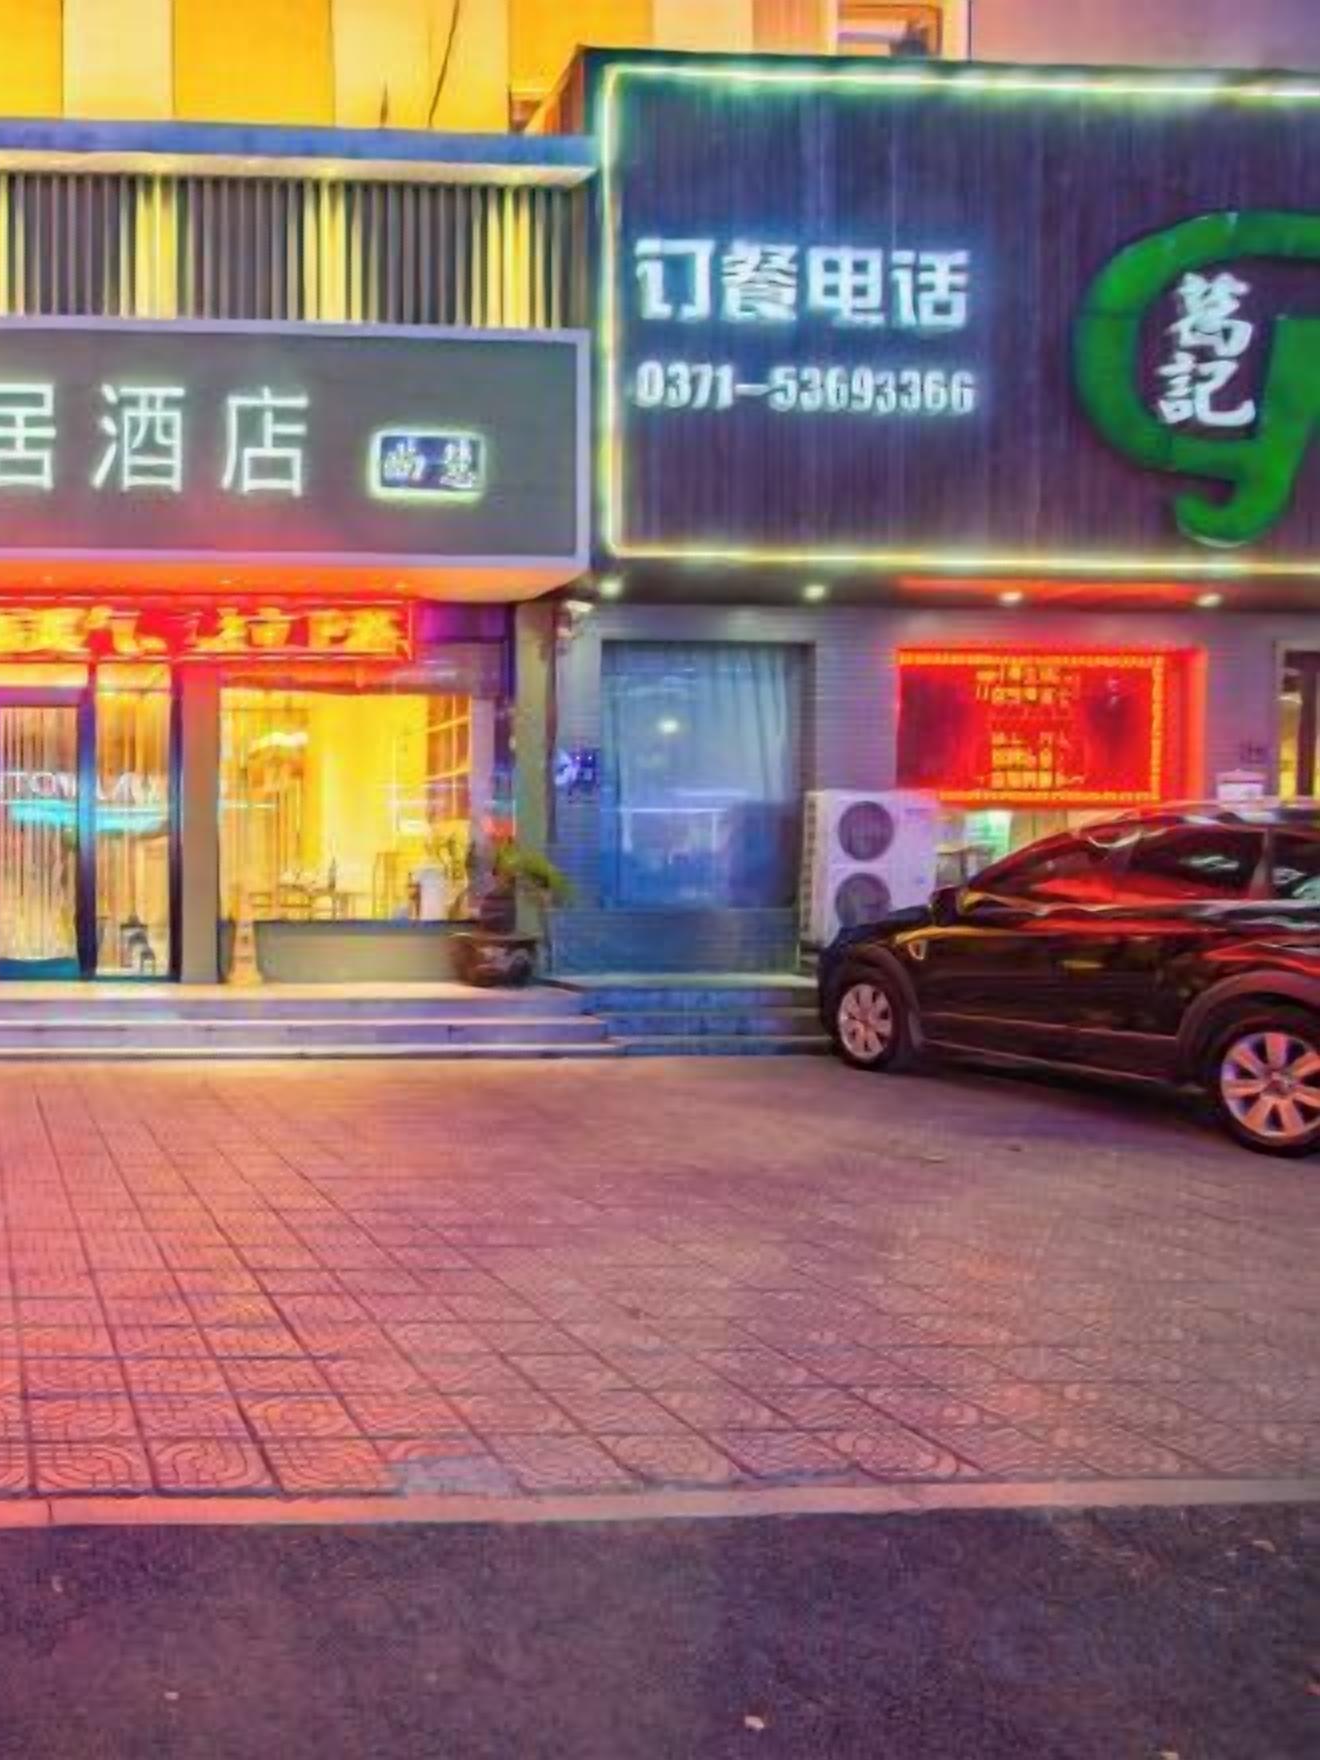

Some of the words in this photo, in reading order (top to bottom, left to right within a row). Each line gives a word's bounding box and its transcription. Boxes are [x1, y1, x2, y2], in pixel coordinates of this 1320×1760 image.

[635, 237, 970, 329] 订餐电话
[1158, 273, 1257, 427] 萬記
